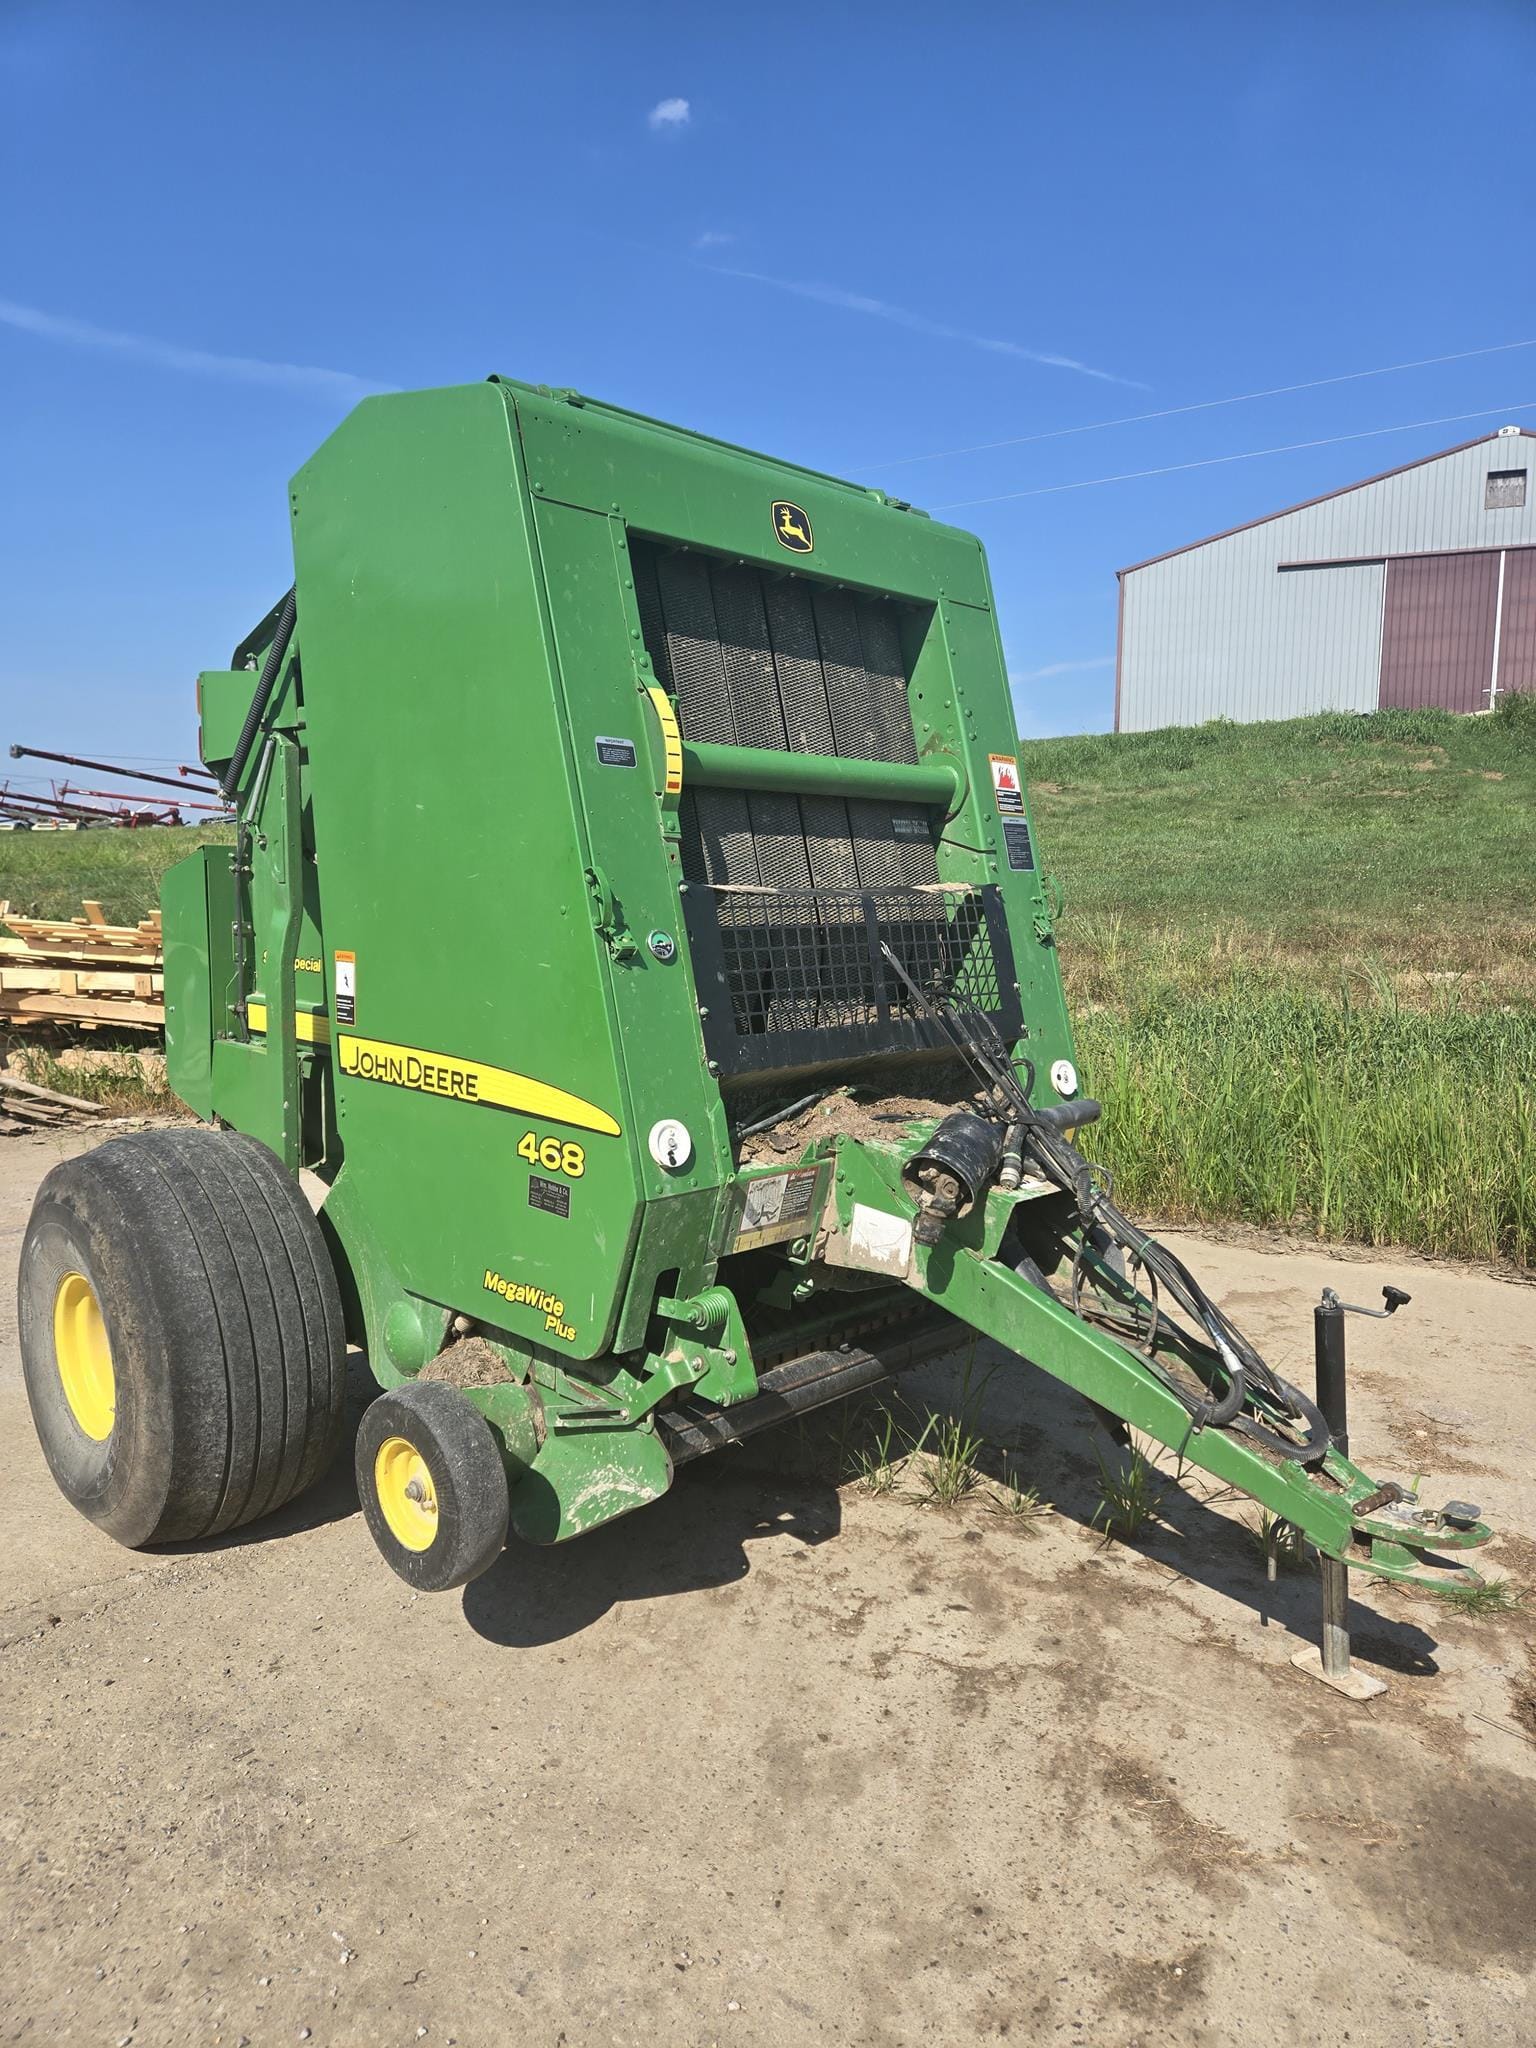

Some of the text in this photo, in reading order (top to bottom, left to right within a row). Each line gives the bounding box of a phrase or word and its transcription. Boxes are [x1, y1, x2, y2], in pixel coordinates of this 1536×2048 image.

[294, 957, 321, 972] pecial
[349, 1046, 478, 1097] JOHN DEERE
[517, 1131, 585, 1178] 468
[483, 1269, 564, 1318] MegaWide
[544, 1313, 576, 1342] Plus
